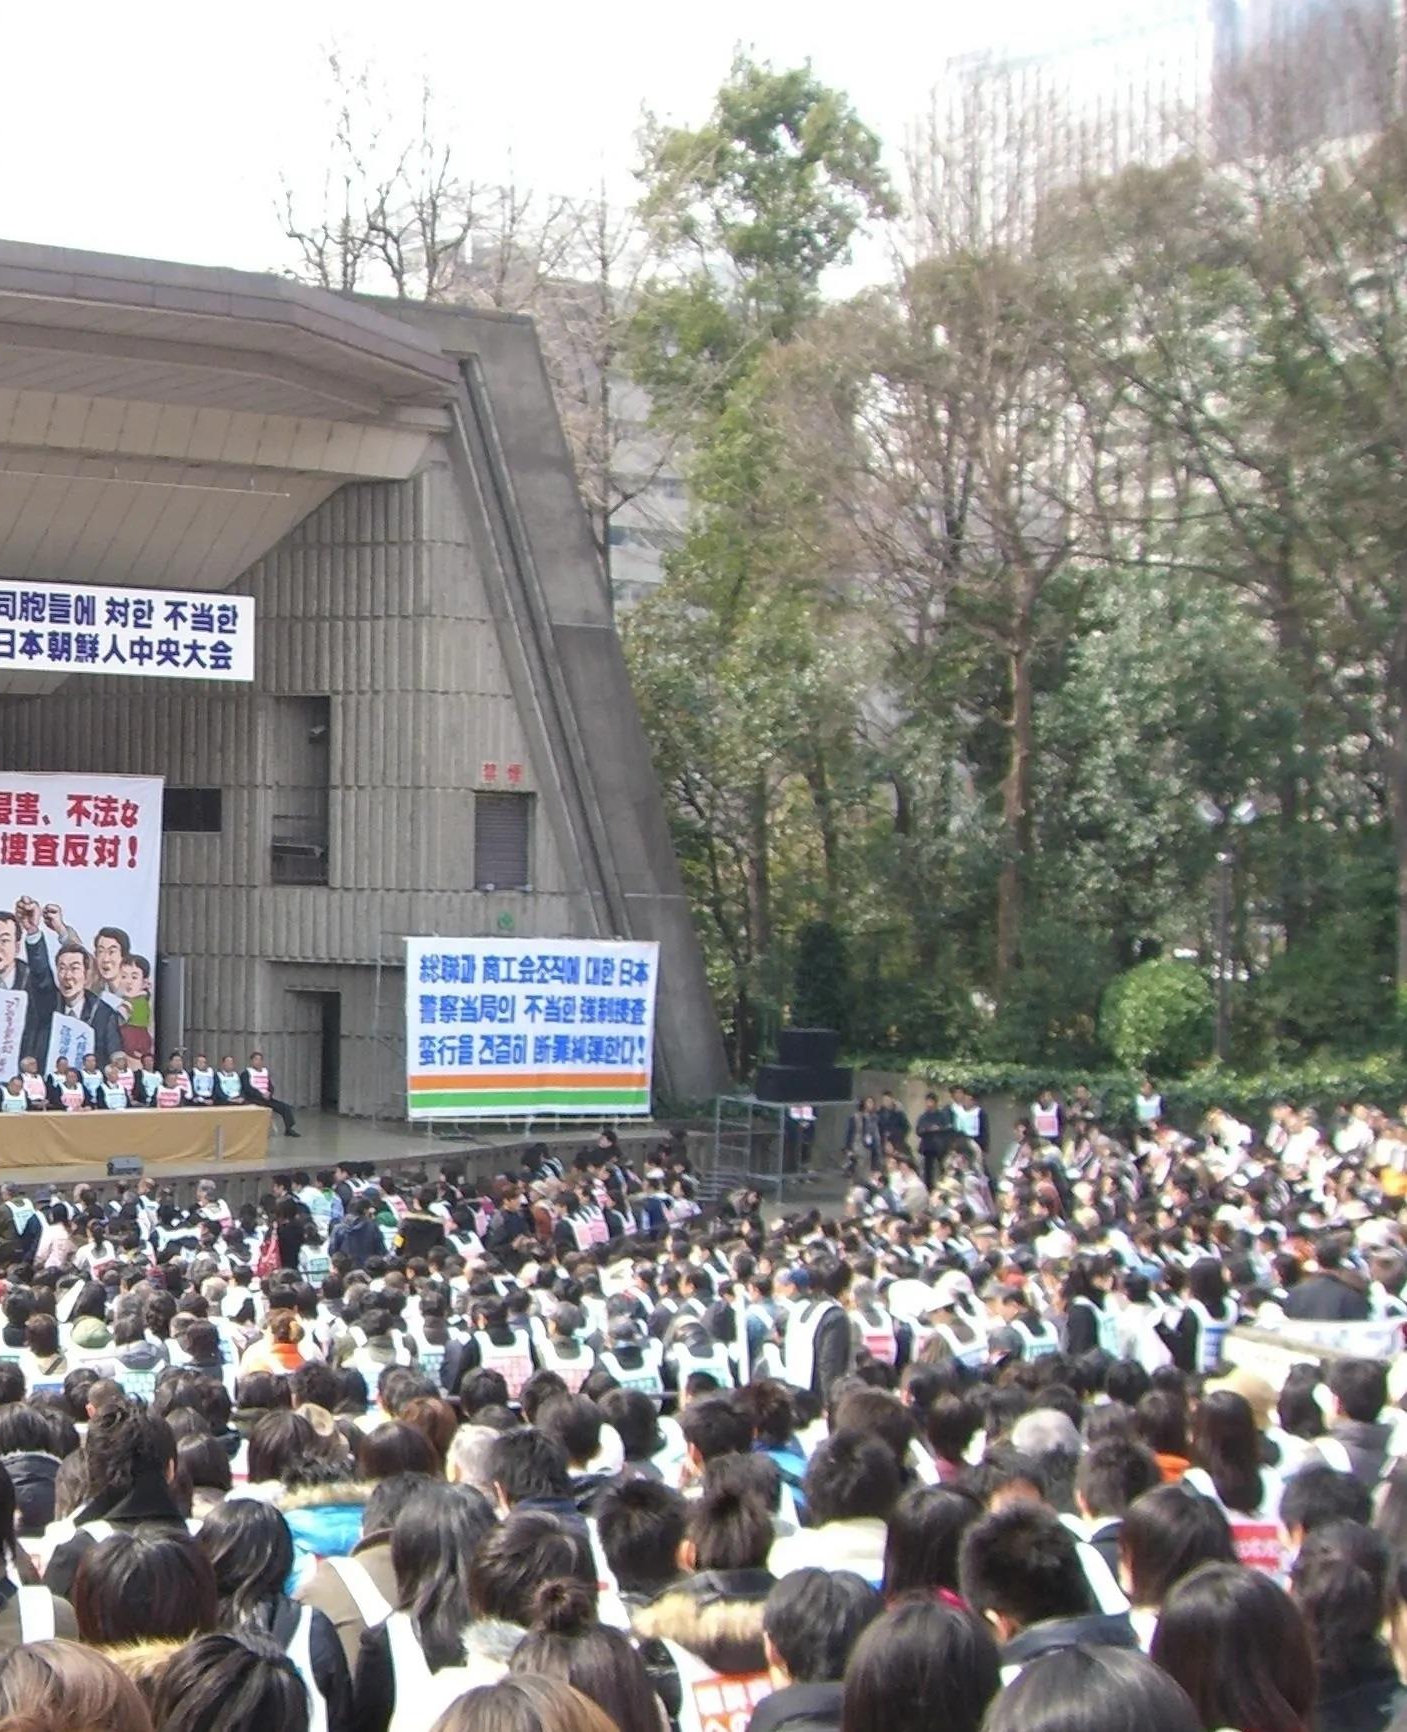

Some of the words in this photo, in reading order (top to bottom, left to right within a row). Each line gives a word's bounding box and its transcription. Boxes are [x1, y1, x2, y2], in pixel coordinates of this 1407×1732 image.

[164, 601, 239, 635] 不当한
[586, 957, 615, 986] 대한
[619, 958, 649, 987] 日本
[524, 995, 577, 1024] 不当한
